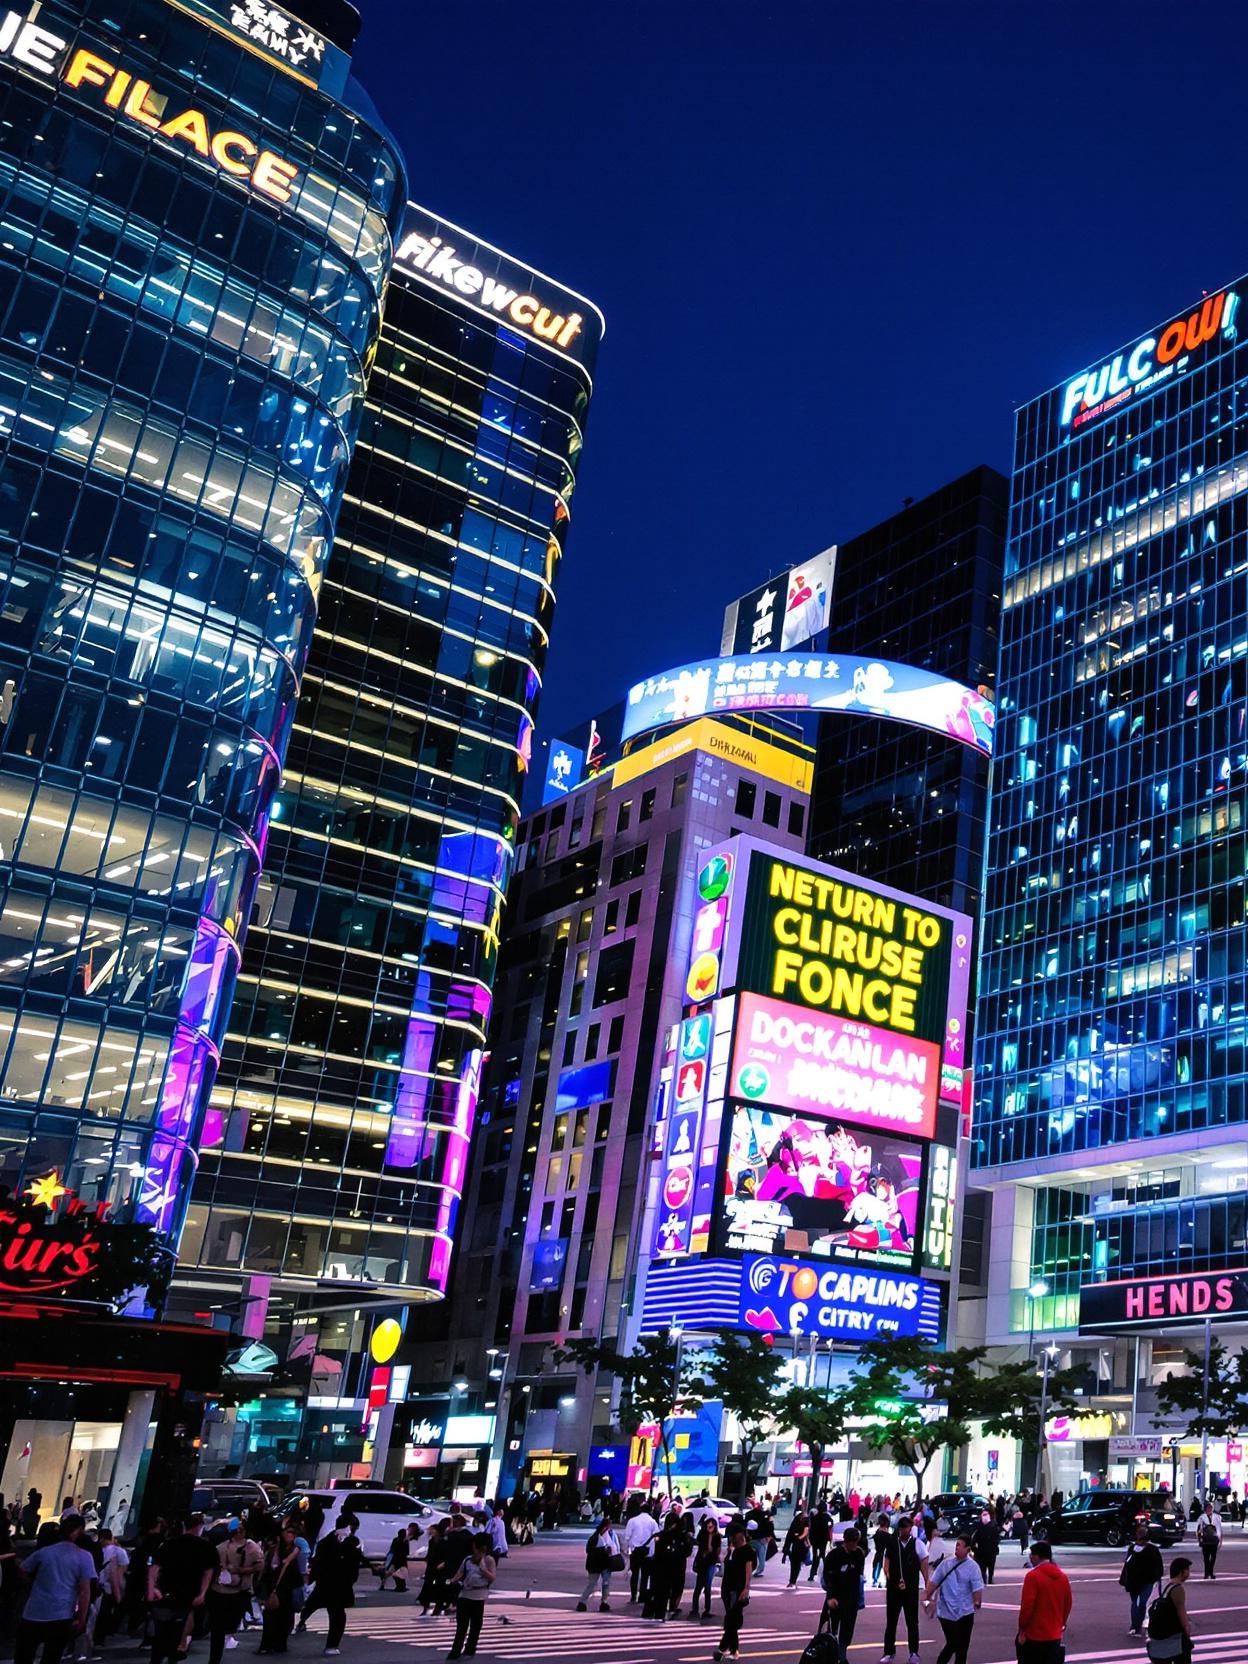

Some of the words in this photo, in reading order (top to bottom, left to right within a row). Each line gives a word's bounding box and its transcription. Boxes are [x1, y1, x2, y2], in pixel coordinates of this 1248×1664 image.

[64, 48, 298, 203] FILACE
[770, 863, 896, 933] NETURN
[903, 899, 941, 947] TO
[774, 908, 923, 984] CLIRUSE
[772, 950, 917, 1031] FONCE
[751, 1011, 927, 1083] DOCKANLAN
[818, 1306, 874, 1330] CITRY
[1126, 1279, 1233, 1318] HENDS
